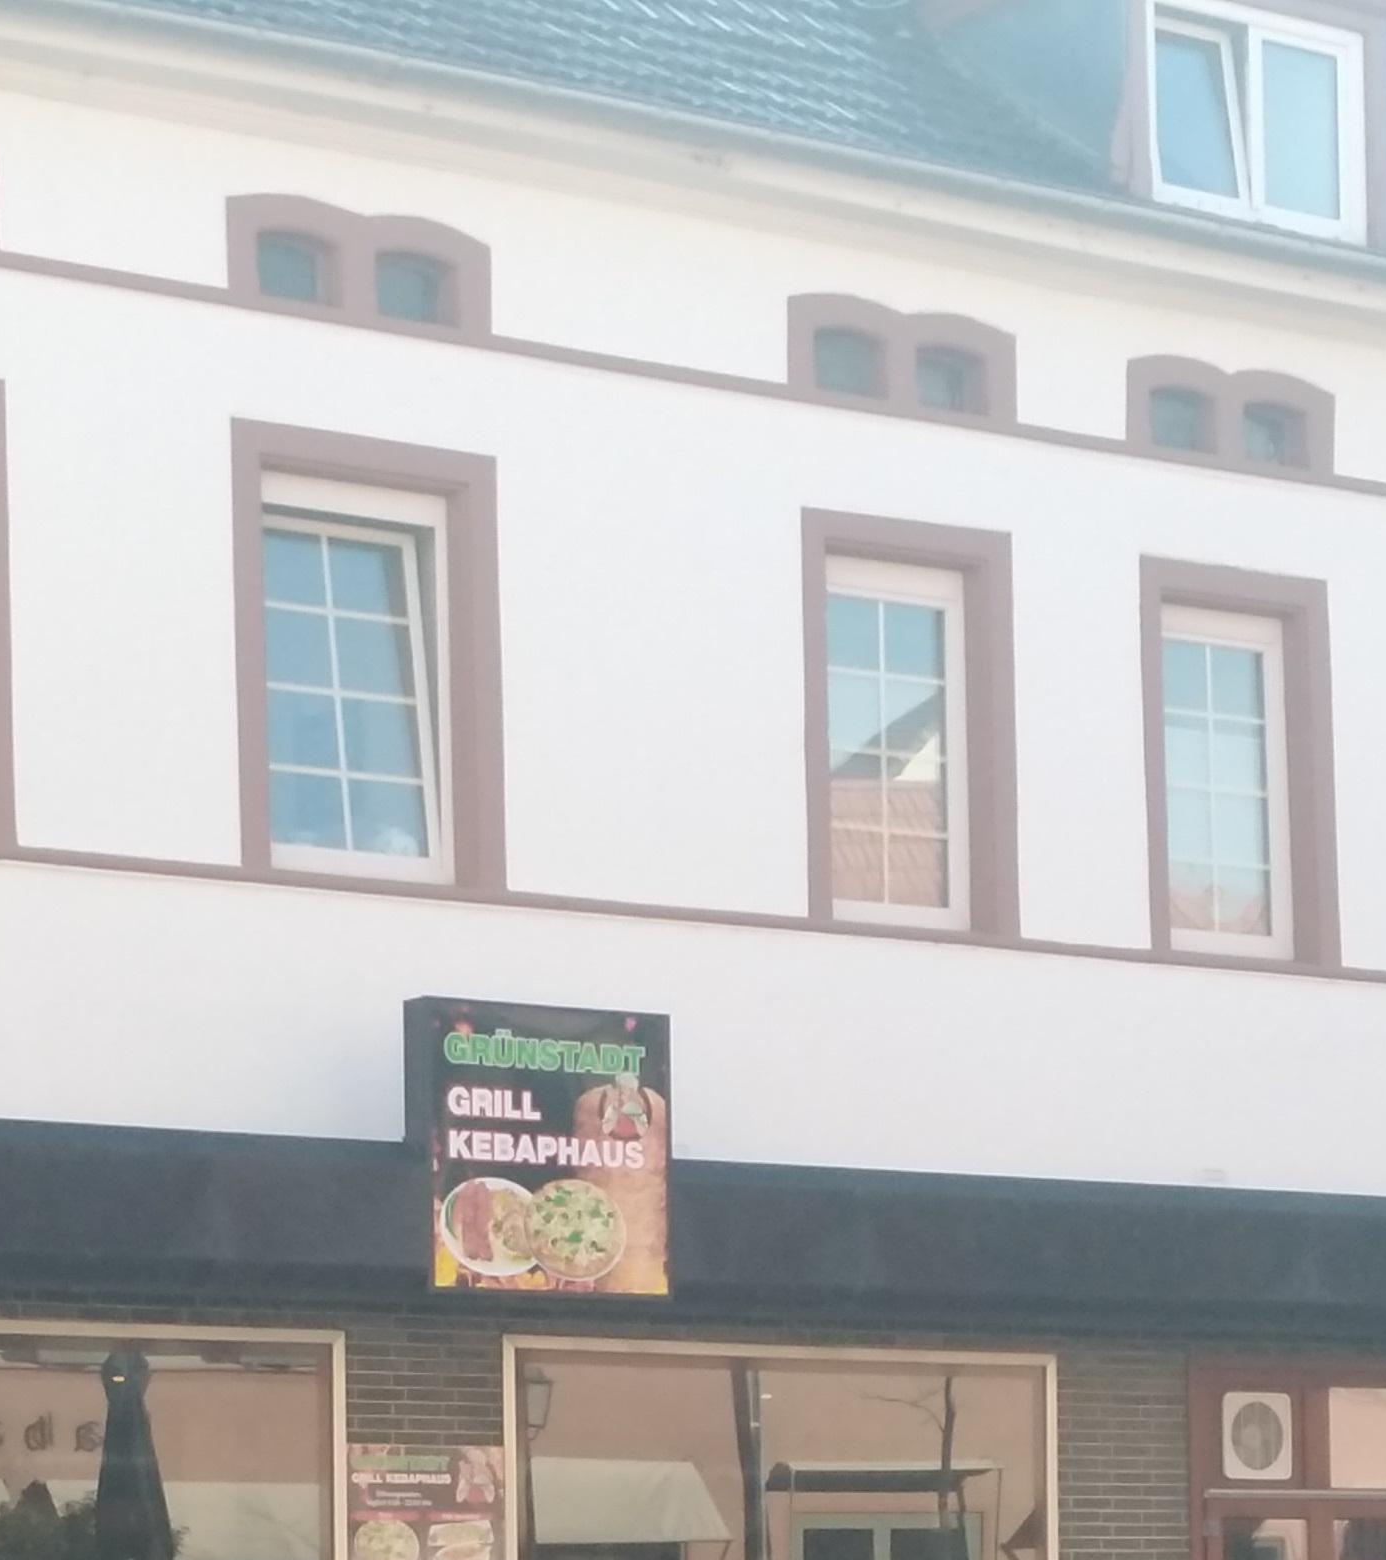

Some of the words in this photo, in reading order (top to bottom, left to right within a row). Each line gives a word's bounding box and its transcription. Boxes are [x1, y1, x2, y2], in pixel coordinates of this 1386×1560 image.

[444, 1028, 645, 1075] GRÜNSTADT
[447, 1086, 542, 1121] GRILL
[448, 1130, 646, 1170] KEBAPHAUS
